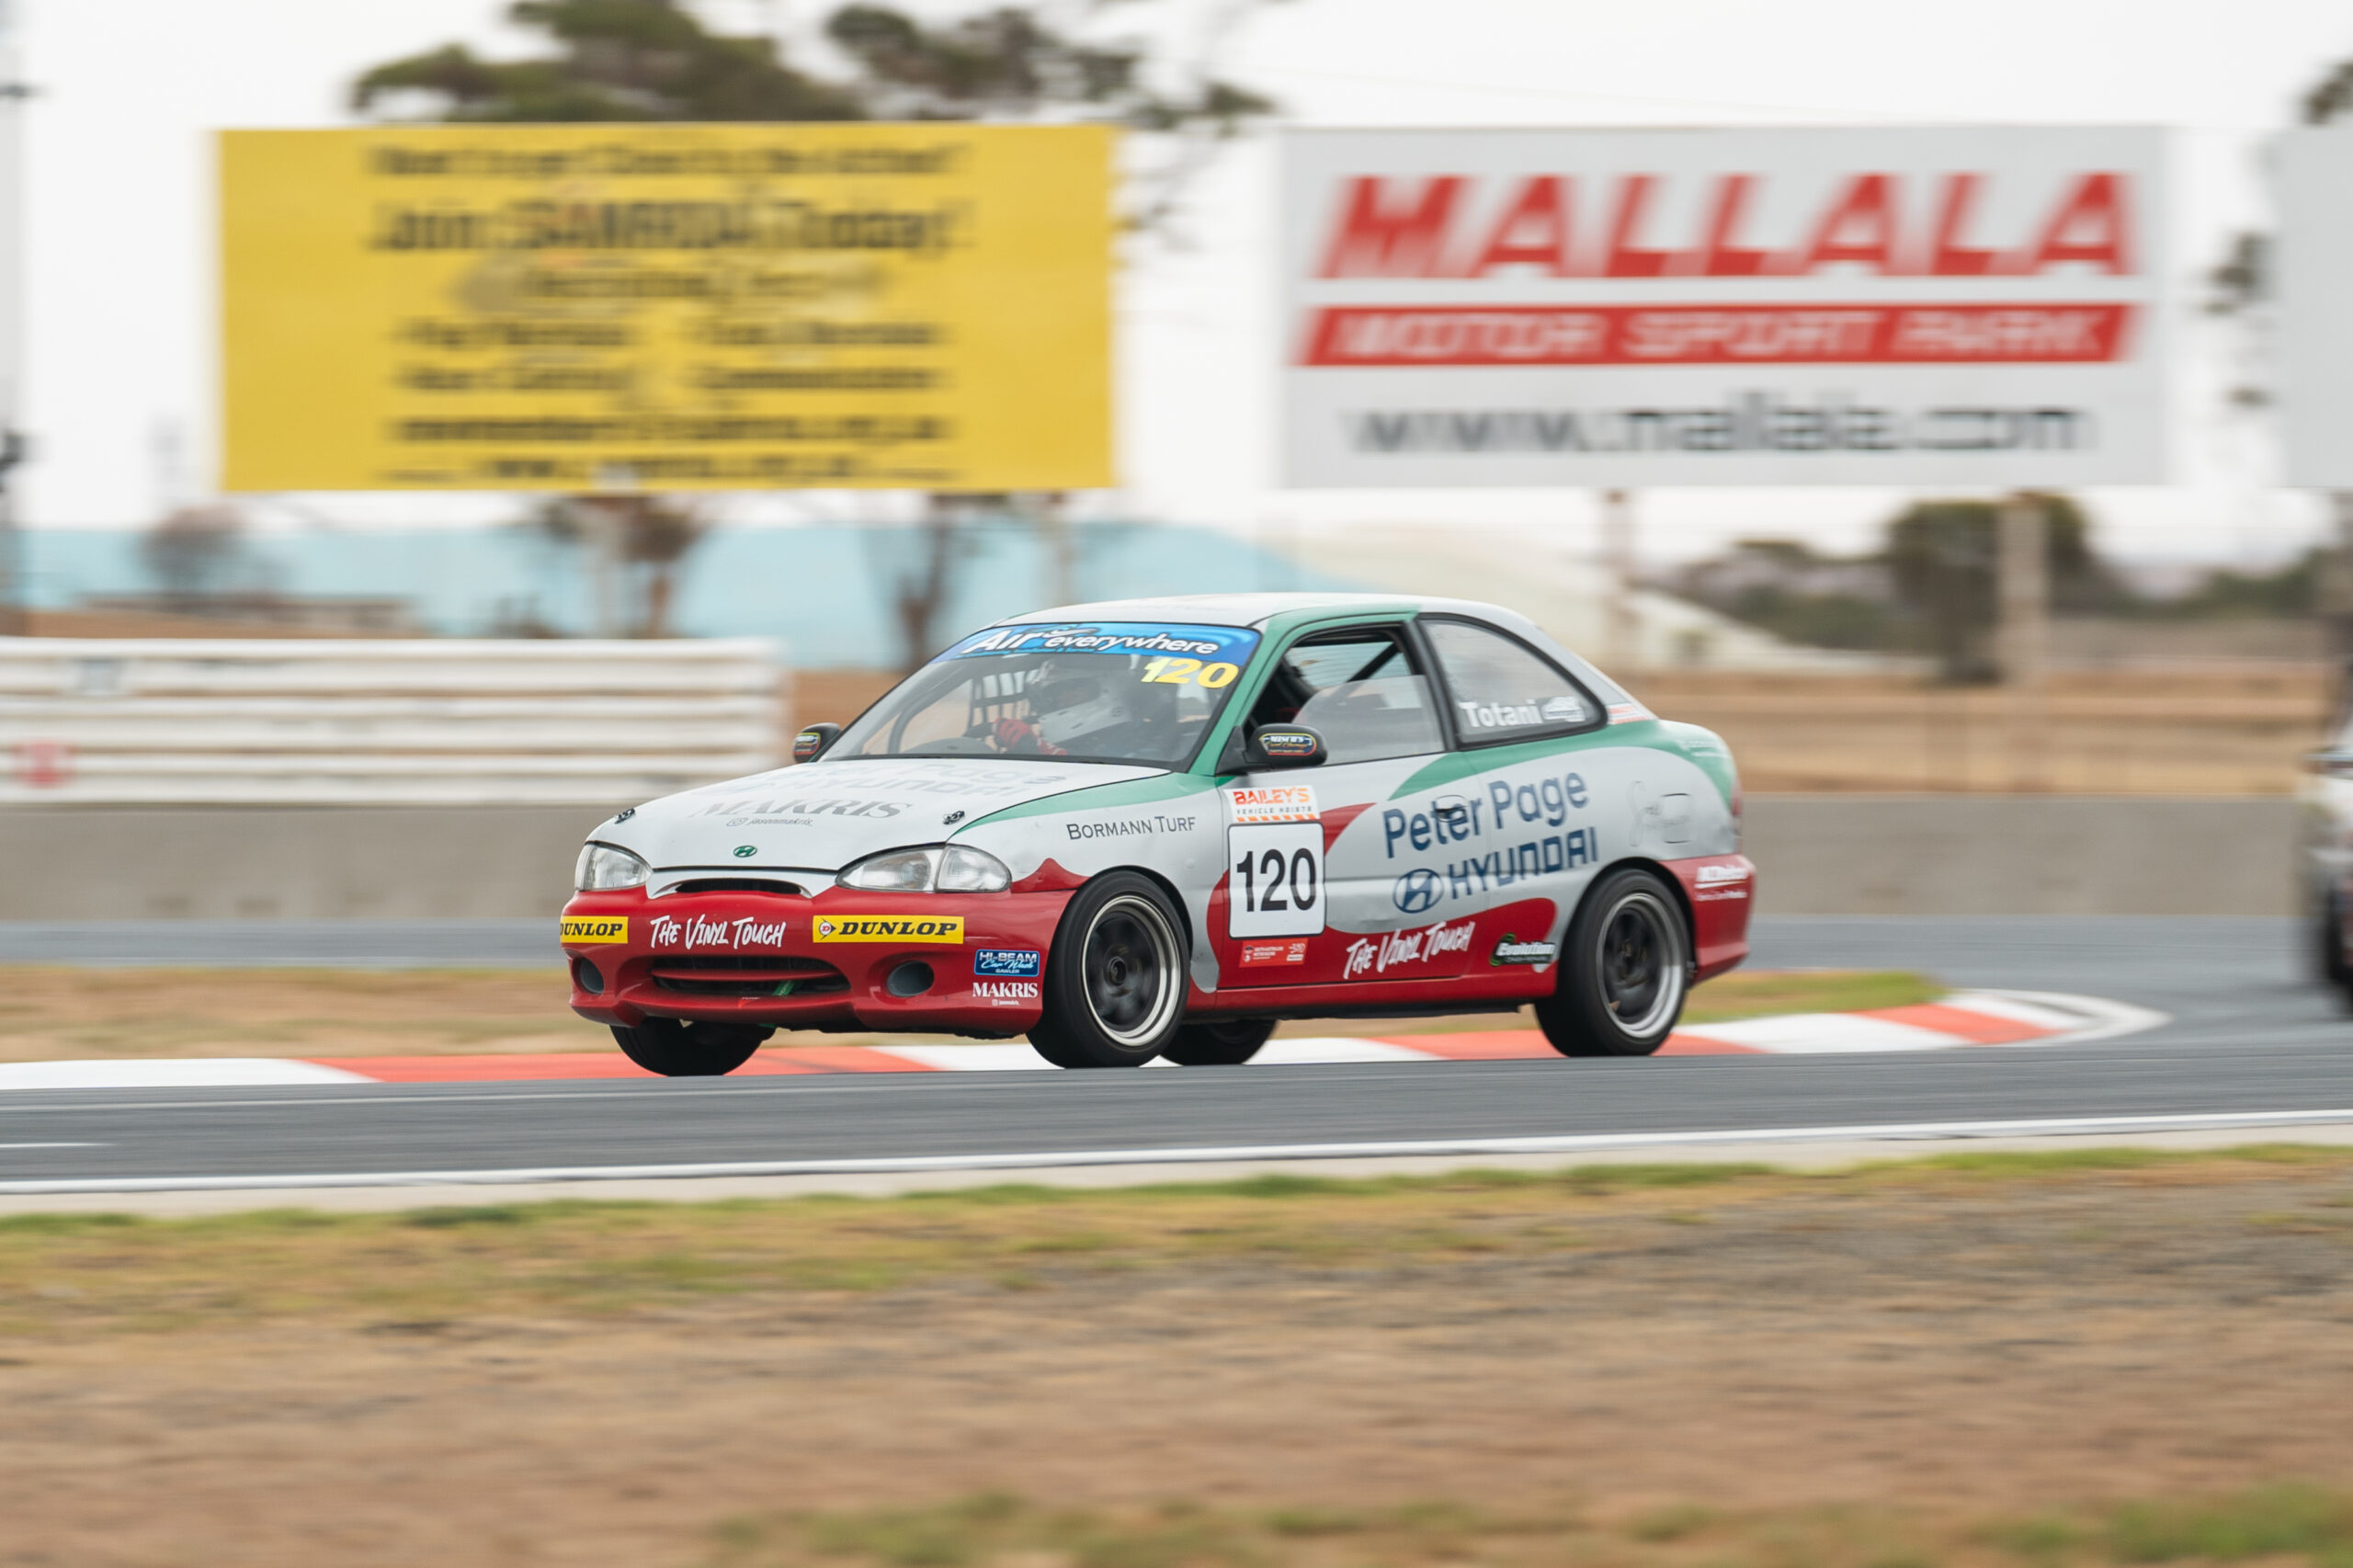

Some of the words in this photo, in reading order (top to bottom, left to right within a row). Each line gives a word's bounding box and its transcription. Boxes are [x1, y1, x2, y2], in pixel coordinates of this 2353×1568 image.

[1311, 173, 2139, 279] MALLALA
[1337, 311, 1599, 359] MOTOR
[1629, 309, 1881, 358] SPORT
[1899, 307, 2101, 356] PARK
[1346, 390, 2092, 452] www.mallala.com
[1044, 633, 1219, 654] everywhere
[1141, 657, 1238, 687] 120
[1458, 699, 1543, 727] Totani
[688, 799, 913, 819] MAKRIS
[1233, 787, 1310, 805] BAILEY'S
[1066, 819, 1153, 840] BORMANN
[1154, 816, 1196, 833] TURF
[1382, 797, 1483, 858] Peter
[1488, 772, 1589, 829] Page
[1448, 826, 1598, 900] HYUNDAI
[1236, 848, 1316, 912] 120
[650, 915, 681, 949] THE
[685, 914, 729, 949] VINYL
[732, 916, 787, 949] TOUCH
[838, 922, 957, 936] DUNLOP
[979, 952, 1037, 962] HI-BEAM
[981, 959, 1003, 969] Car
[1343, 937, 1378, 980] THE
[1376, 928, 1423, 973] VINYL
[1422, 921, 1476, 962] TOUCH
[972, 982, 1039, 998] MAKRIS
